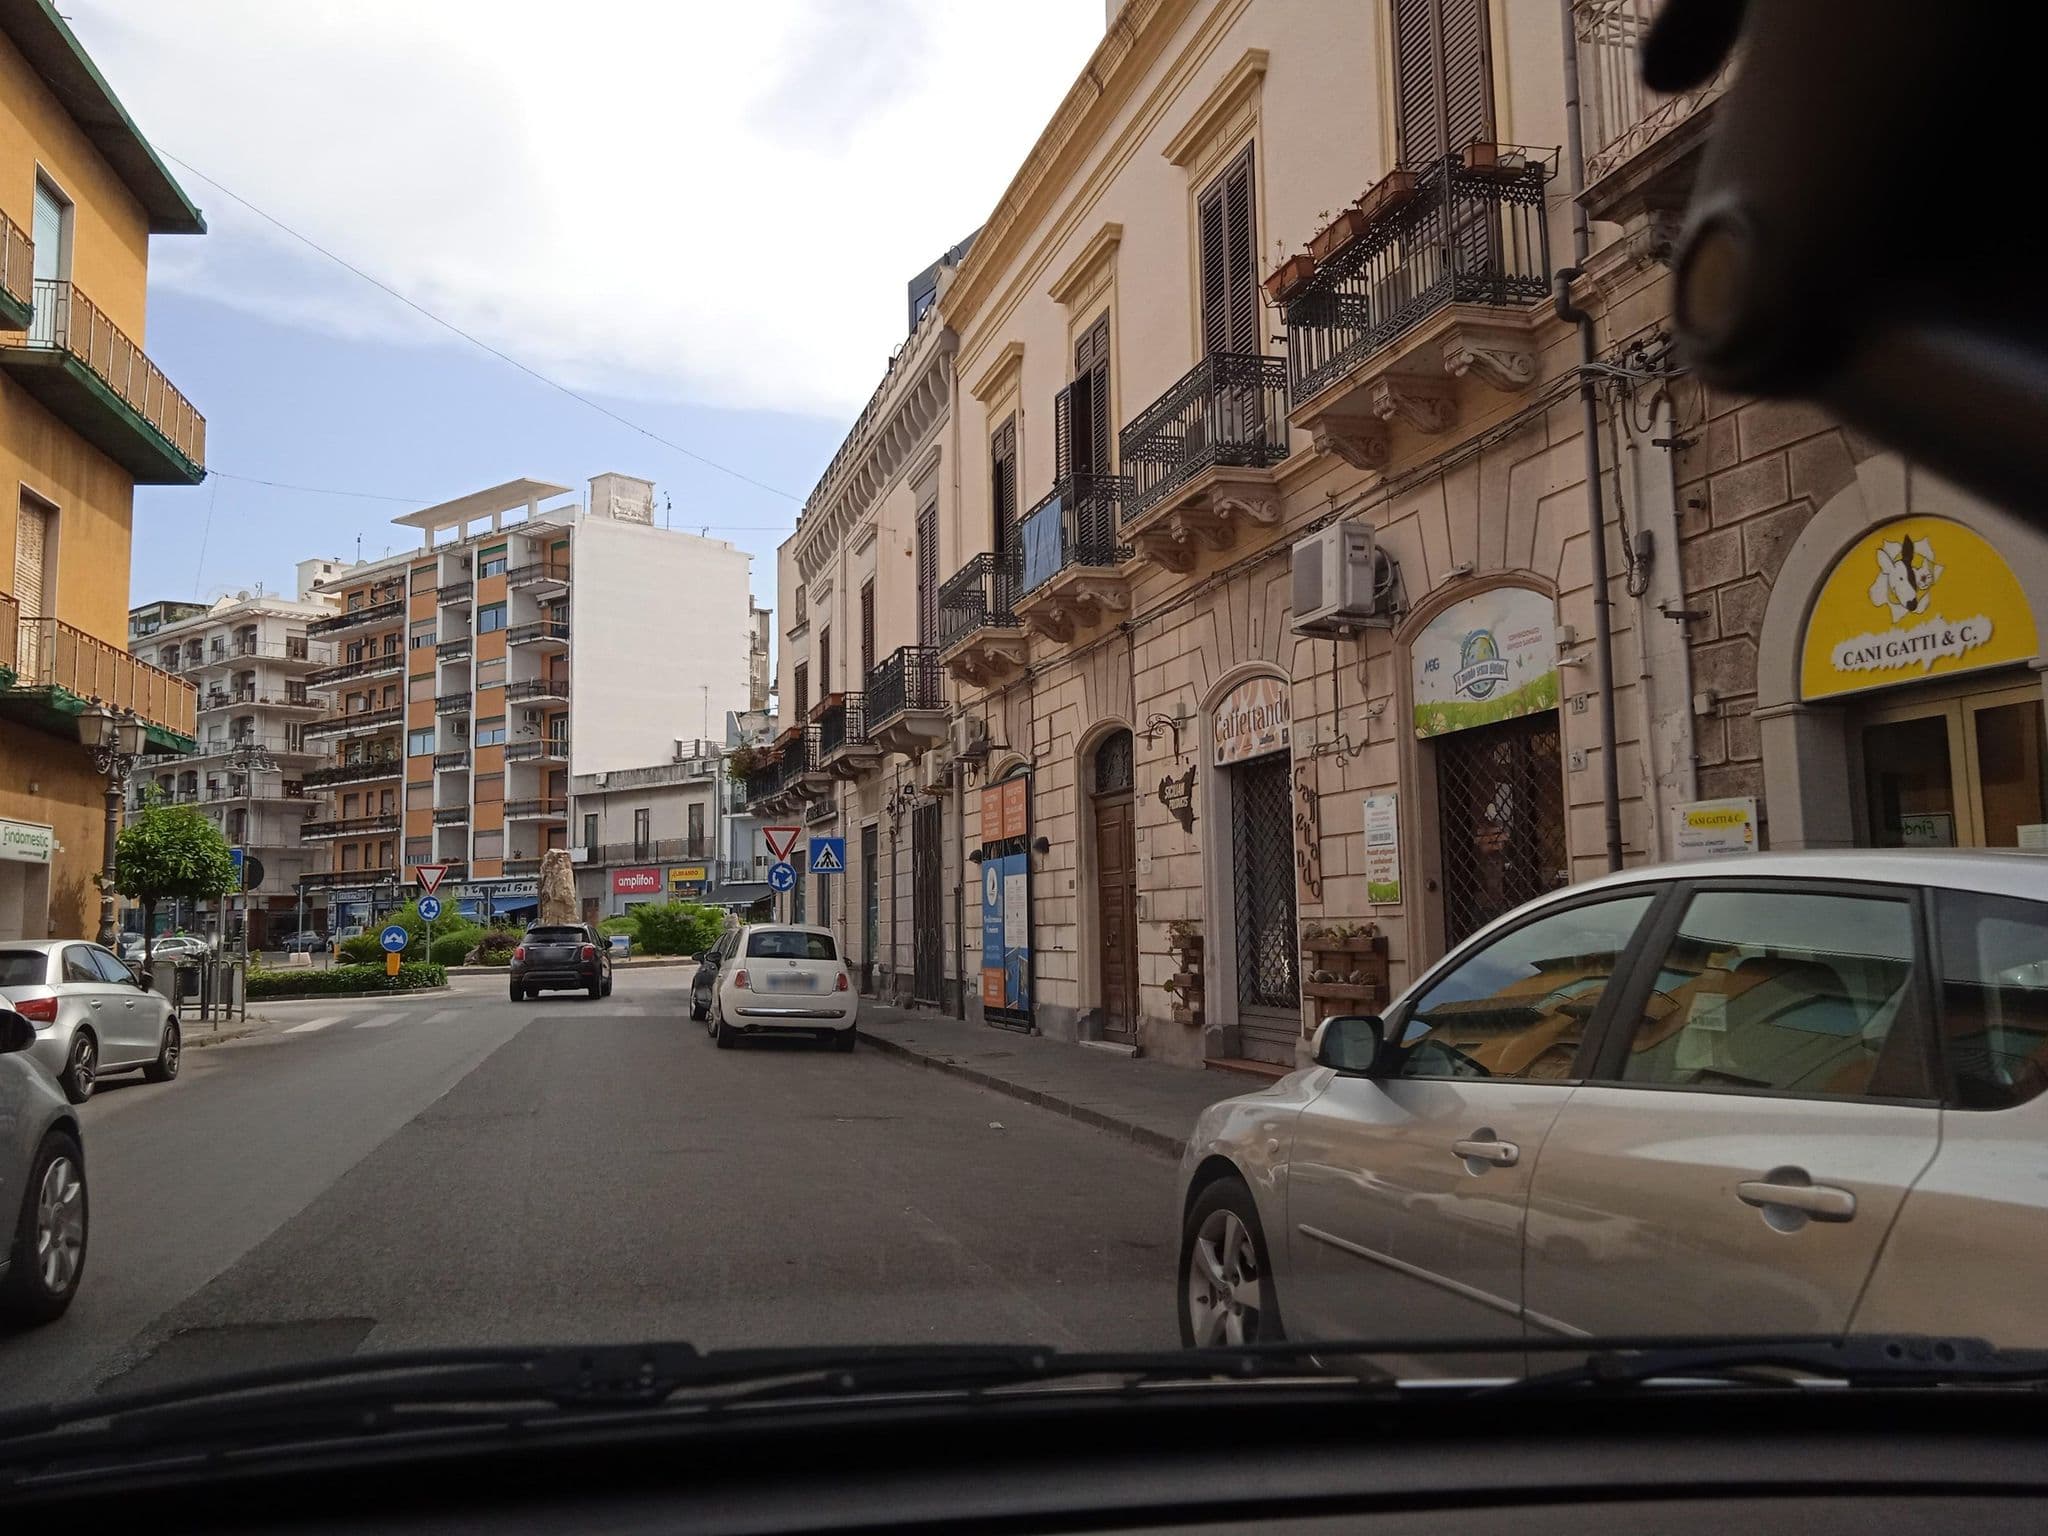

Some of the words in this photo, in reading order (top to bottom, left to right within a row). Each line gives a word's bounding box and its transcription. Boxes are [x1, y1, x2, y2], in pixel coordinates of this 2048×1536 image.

[1843, 645, 1882, 666] CANI
[1886, 633, 1936, 657] GATTI
[1942, 630, 1955, 646] &
[1960, 626, 1978, 643] C.
[1575, 696, 1584, 710] 15
[1215, 690, 1290, 742] Caffettando
[1689, 816, 1706, 826] CANI
[1706, 815, 1727, 825] GATTI
[3, 825, 49, 848] Findomestic
[514, 883, 533, 893] Bar
[618, 873, 654, 889] amplifon
